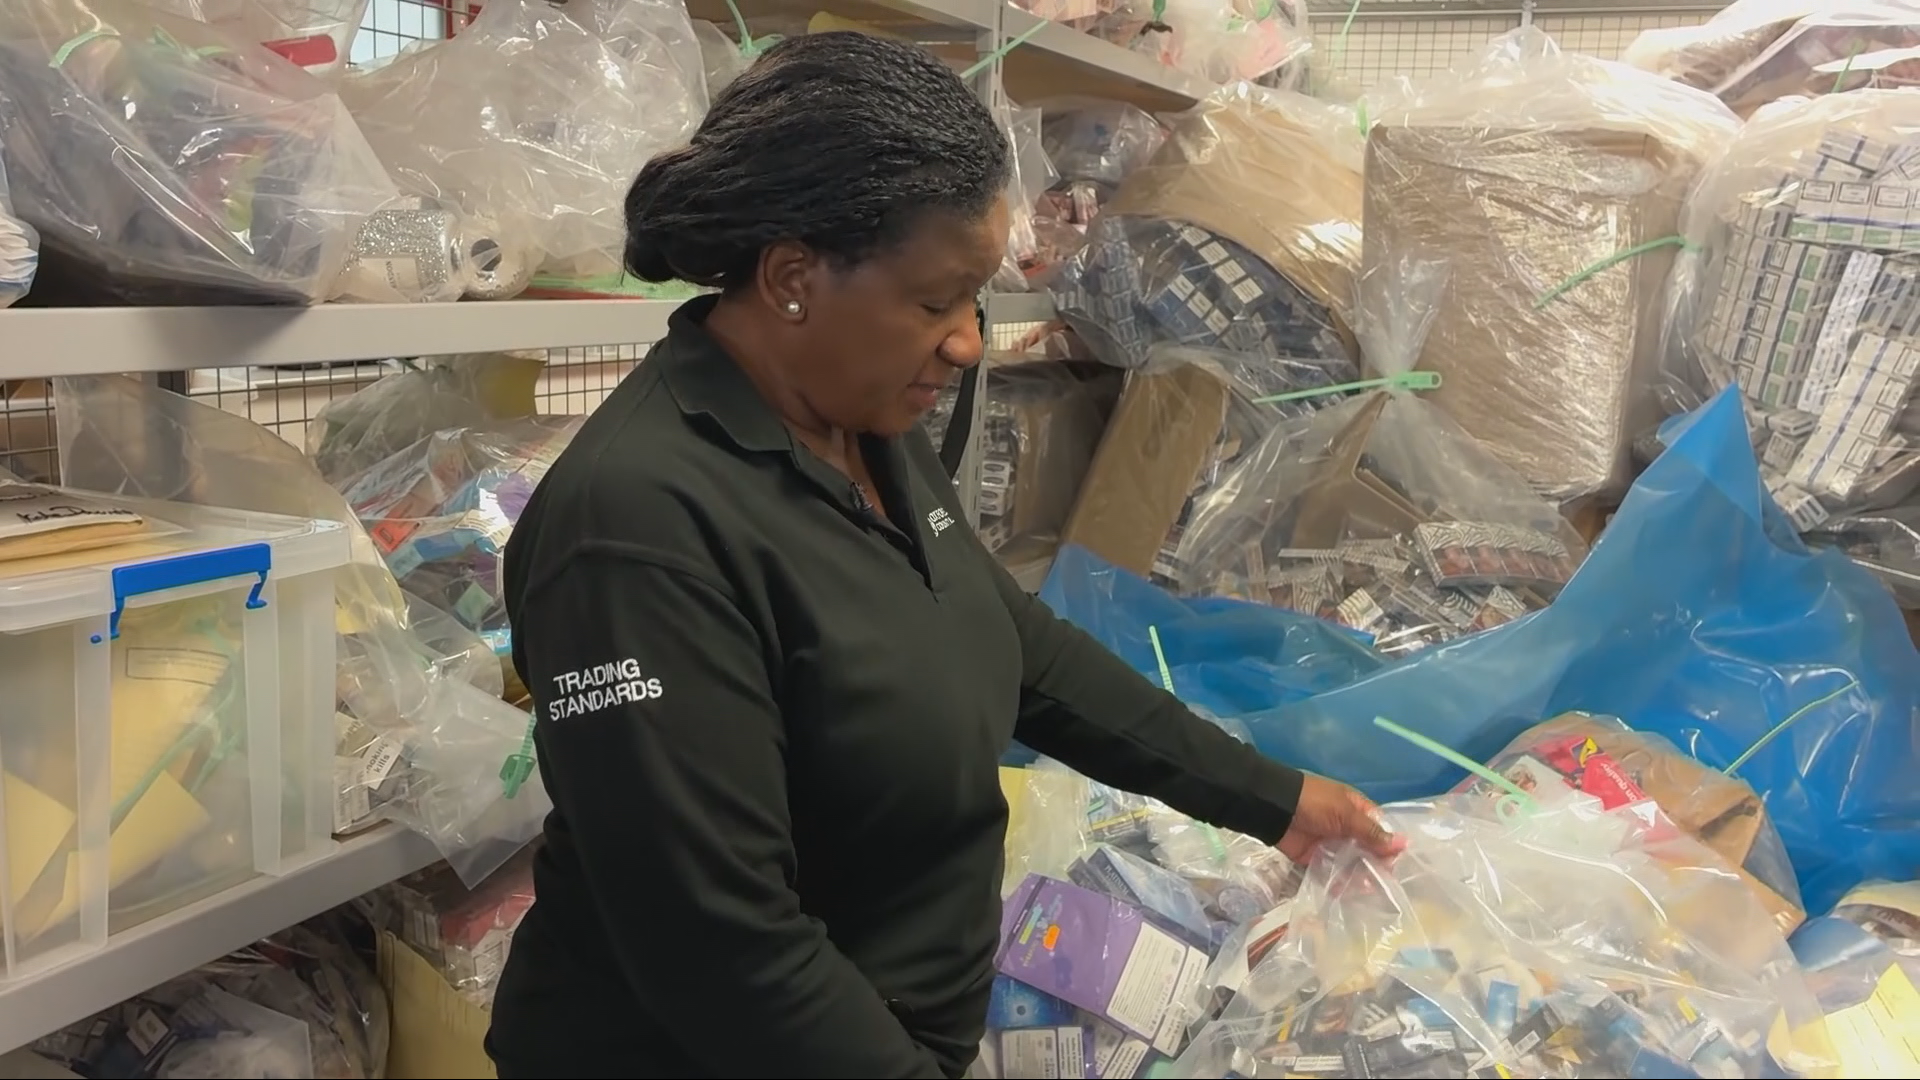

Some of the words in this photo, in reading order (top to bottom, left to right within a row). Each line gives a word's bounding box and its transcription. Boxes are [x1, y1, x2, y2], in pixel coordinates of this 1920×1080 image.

[553, 658, 641, 695] TRADING
[549, 678, 663, 721] STANDARDS
[373, 754, 391, 774] kills
